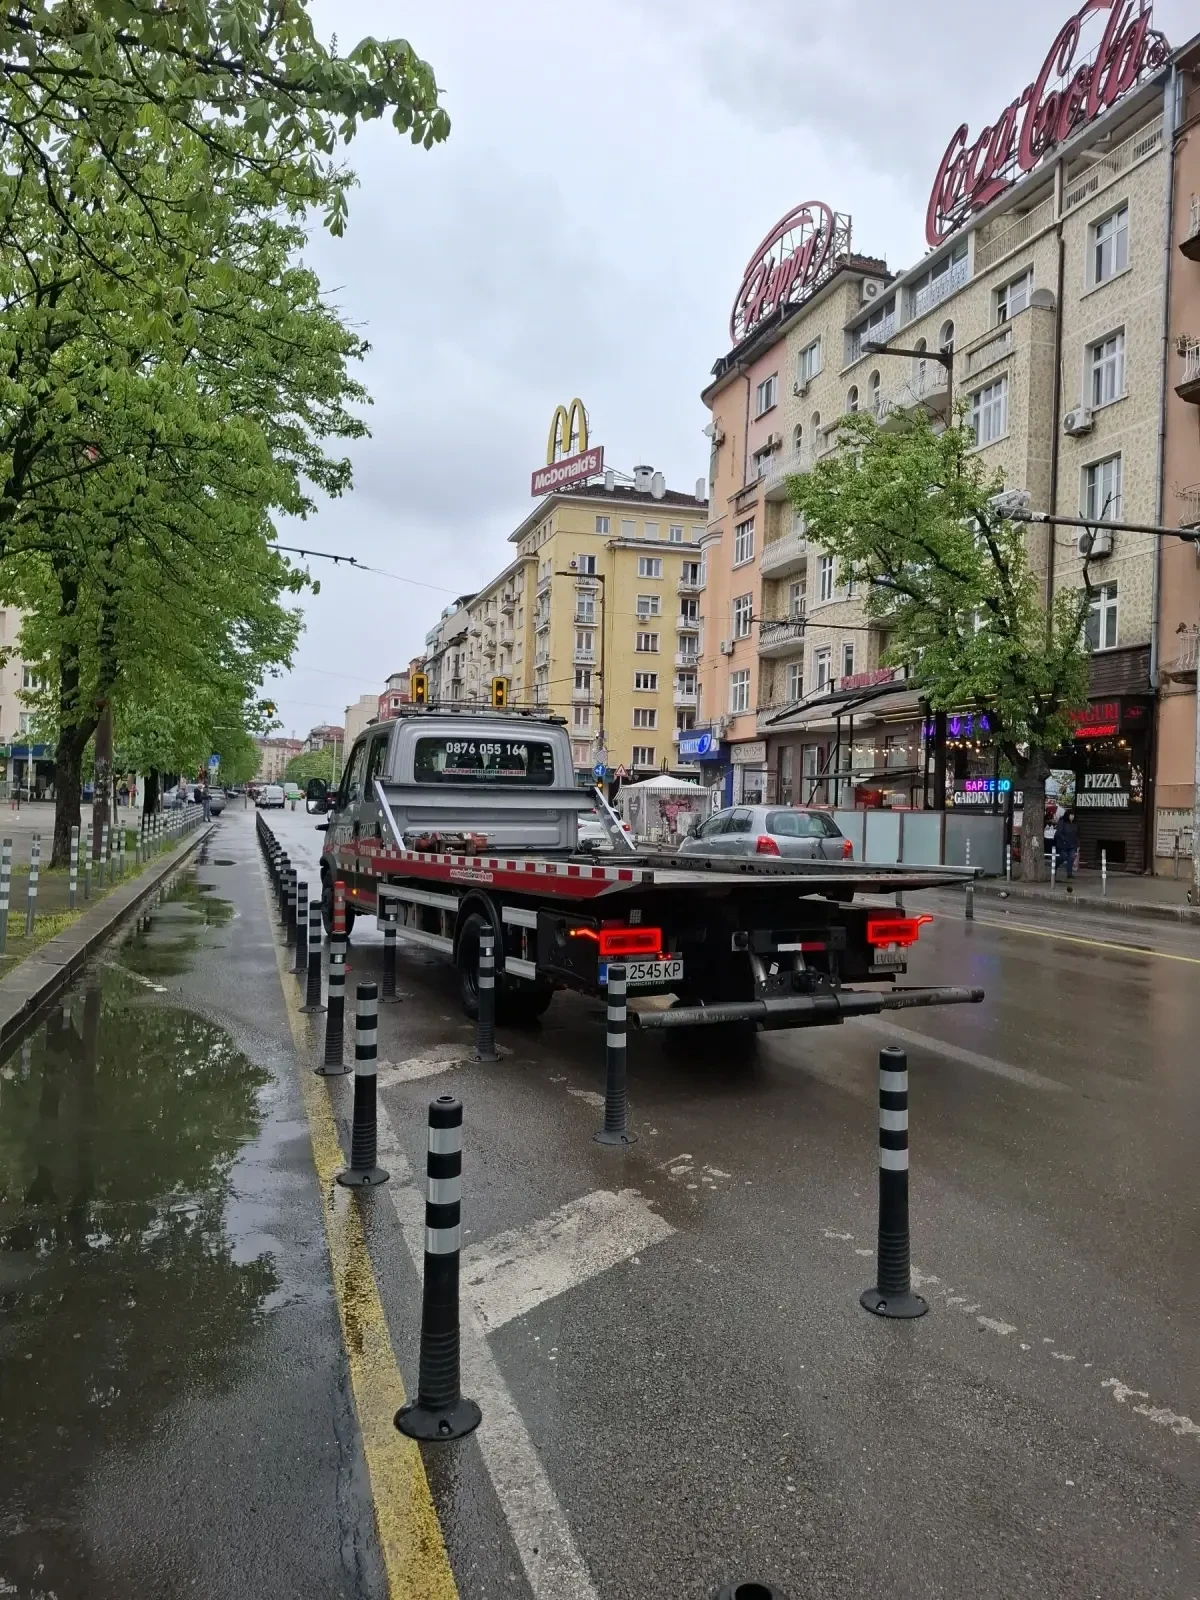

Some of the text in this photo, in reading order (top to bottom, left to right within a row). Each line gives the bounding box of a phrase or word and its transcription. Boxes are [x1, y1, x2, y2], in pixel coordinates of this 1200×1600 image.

[738, 218, 824, 334] Happy
[534, 455, 597, 490] McDonald's
[446, 742, 476, 754] 0876
[480, 743, 502, 755] 055
[965, 780, 1010, 791] БАРБЕЮ
[1084, 773, 1122, 788] PIZZA
[954, 791, 989, 804] GARDEN
[1076, 793, 1129, 807] RESTAURANT
[630, 963, 662, 980] 2545
